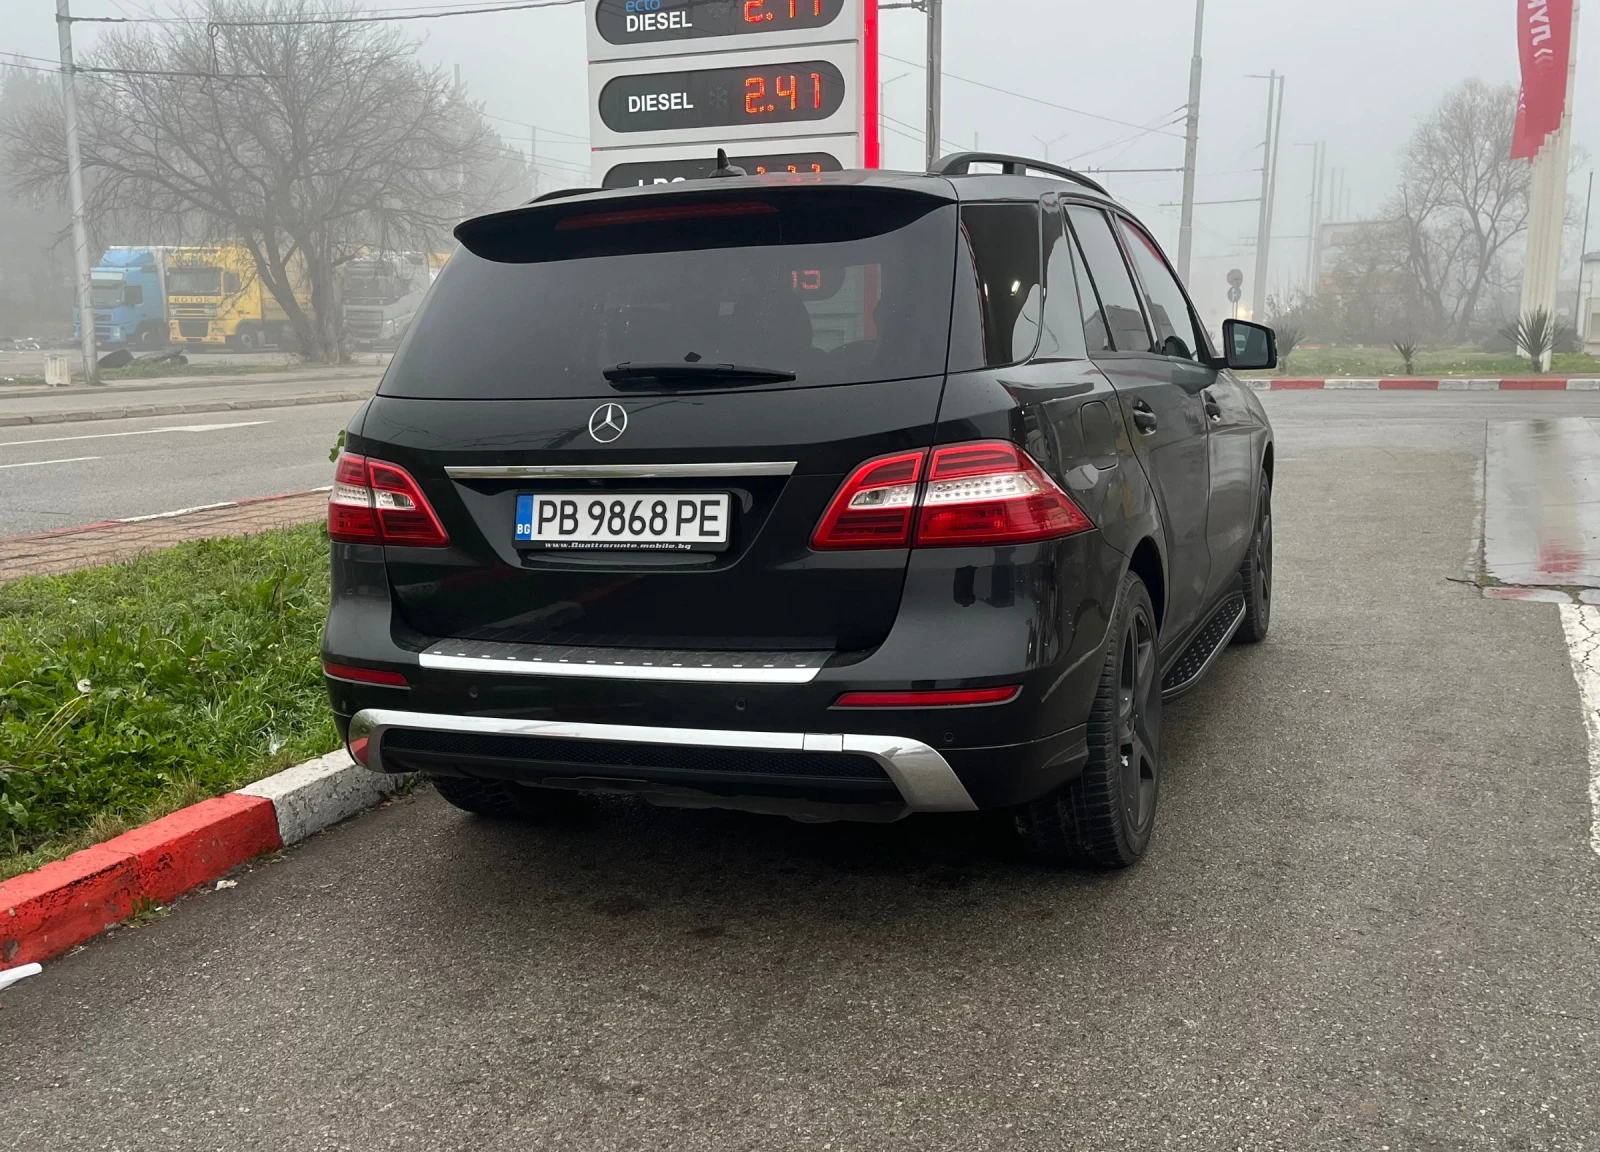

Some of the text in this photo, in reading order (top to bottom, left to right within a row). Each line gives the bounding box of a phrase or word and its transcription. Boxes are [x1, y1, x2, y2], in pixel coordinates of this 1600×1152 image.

[625, 0, 661, 12] ecto
[626, 11, 693, 32] DIESEL
[628, 92, 694, 112] DIESEL
[745, 72, 821, 113] 2.41
[537, 499, 721, 536] PB 9868 PE
[517, 525, 531, 535] BG
